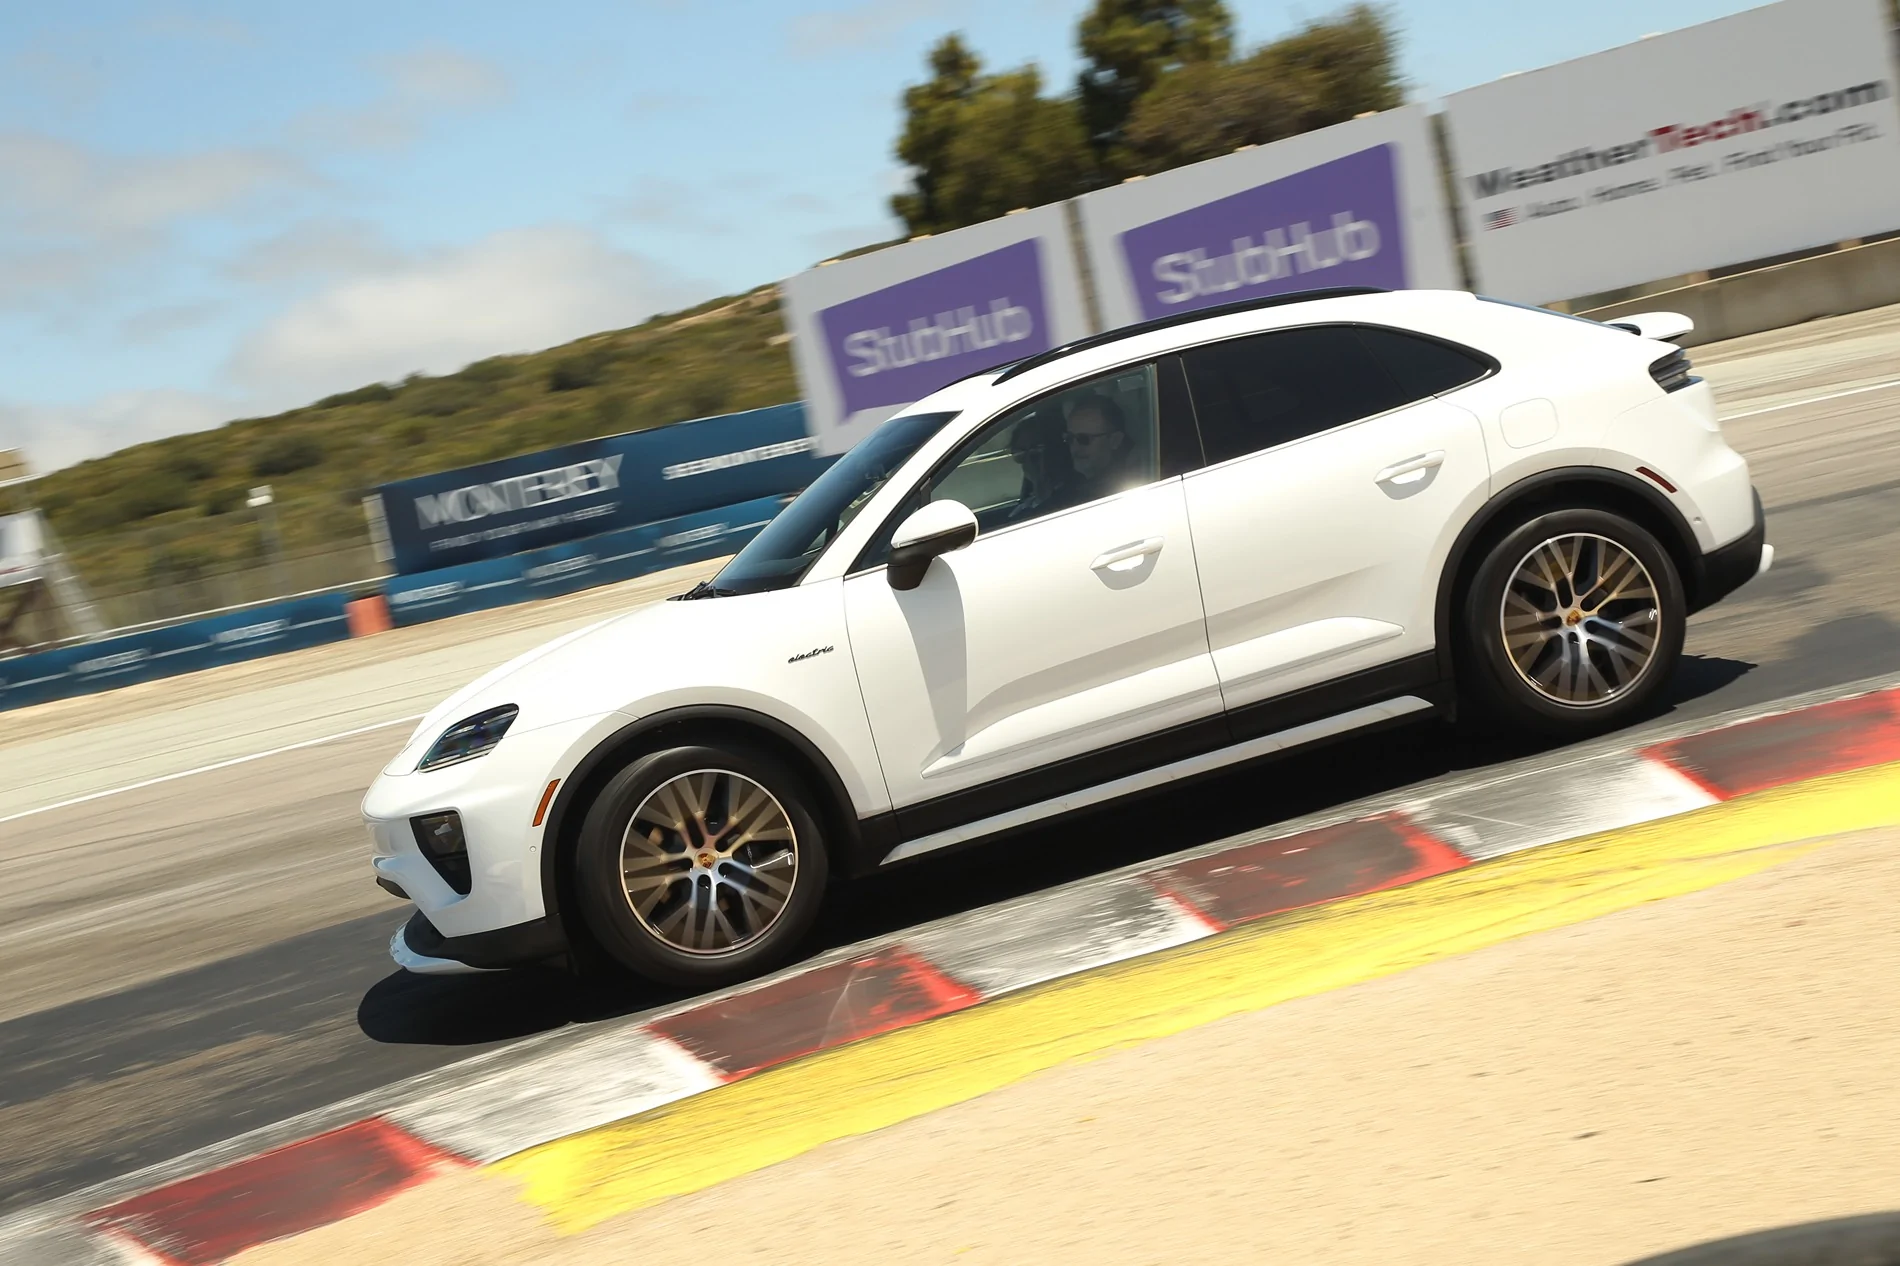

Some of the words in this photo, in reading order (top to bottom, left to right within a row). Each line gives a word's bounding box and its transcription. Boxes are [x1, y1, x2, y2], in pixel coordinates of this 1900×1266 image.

[1468, 79, 1890, 199] WeatherTech.com
[1152, 210, 1382, 305] StubHub
[843, 298, 1033, 379] StubHub
[414, 453, 624, 531] MONTEREY
[788, 645, 834, 664] electric
